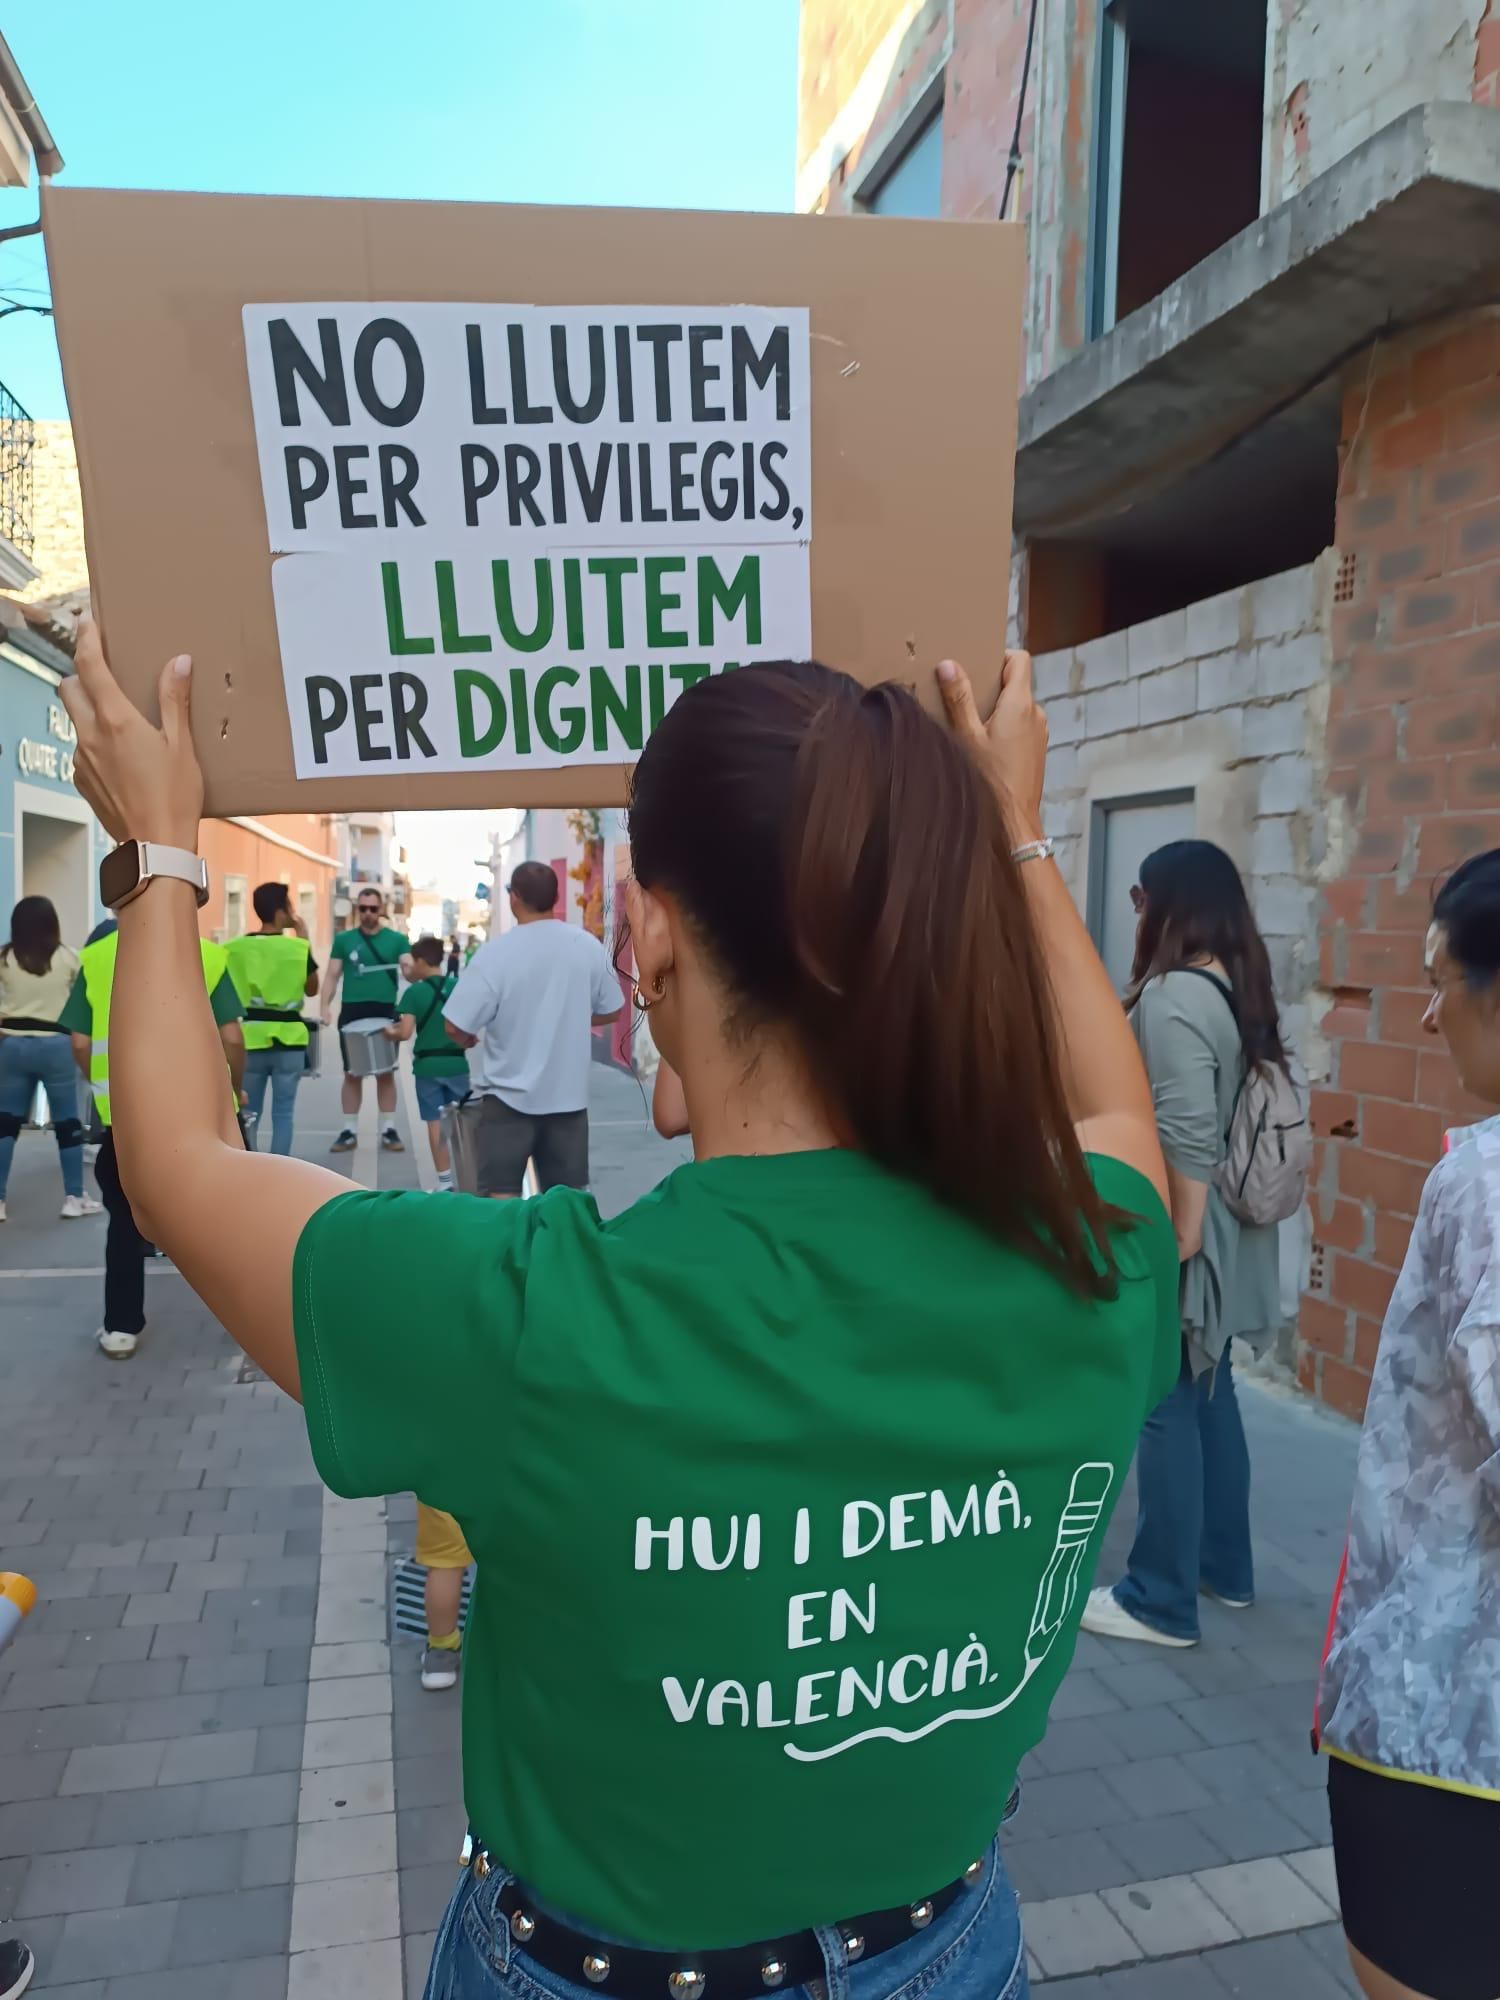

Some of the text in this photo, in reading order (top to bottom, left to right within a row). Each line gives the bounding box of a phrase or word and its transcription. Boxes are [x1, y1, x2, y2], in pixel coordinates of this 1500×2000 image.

[267, 317, 792, 428] NO LLUITEM
[283, 440, 804, 531] PER PRIVILEGIS,
[380, 555, 762, 656] LLUITEM
[304, 660, 766, 765] PER DIGNIT
[634, 1469, 1032, 1571] HUI I DEMÀ,
[787, 1582, 876, 1650] EN
[661, 1632, 999, 1728] VALENCIÀ.
